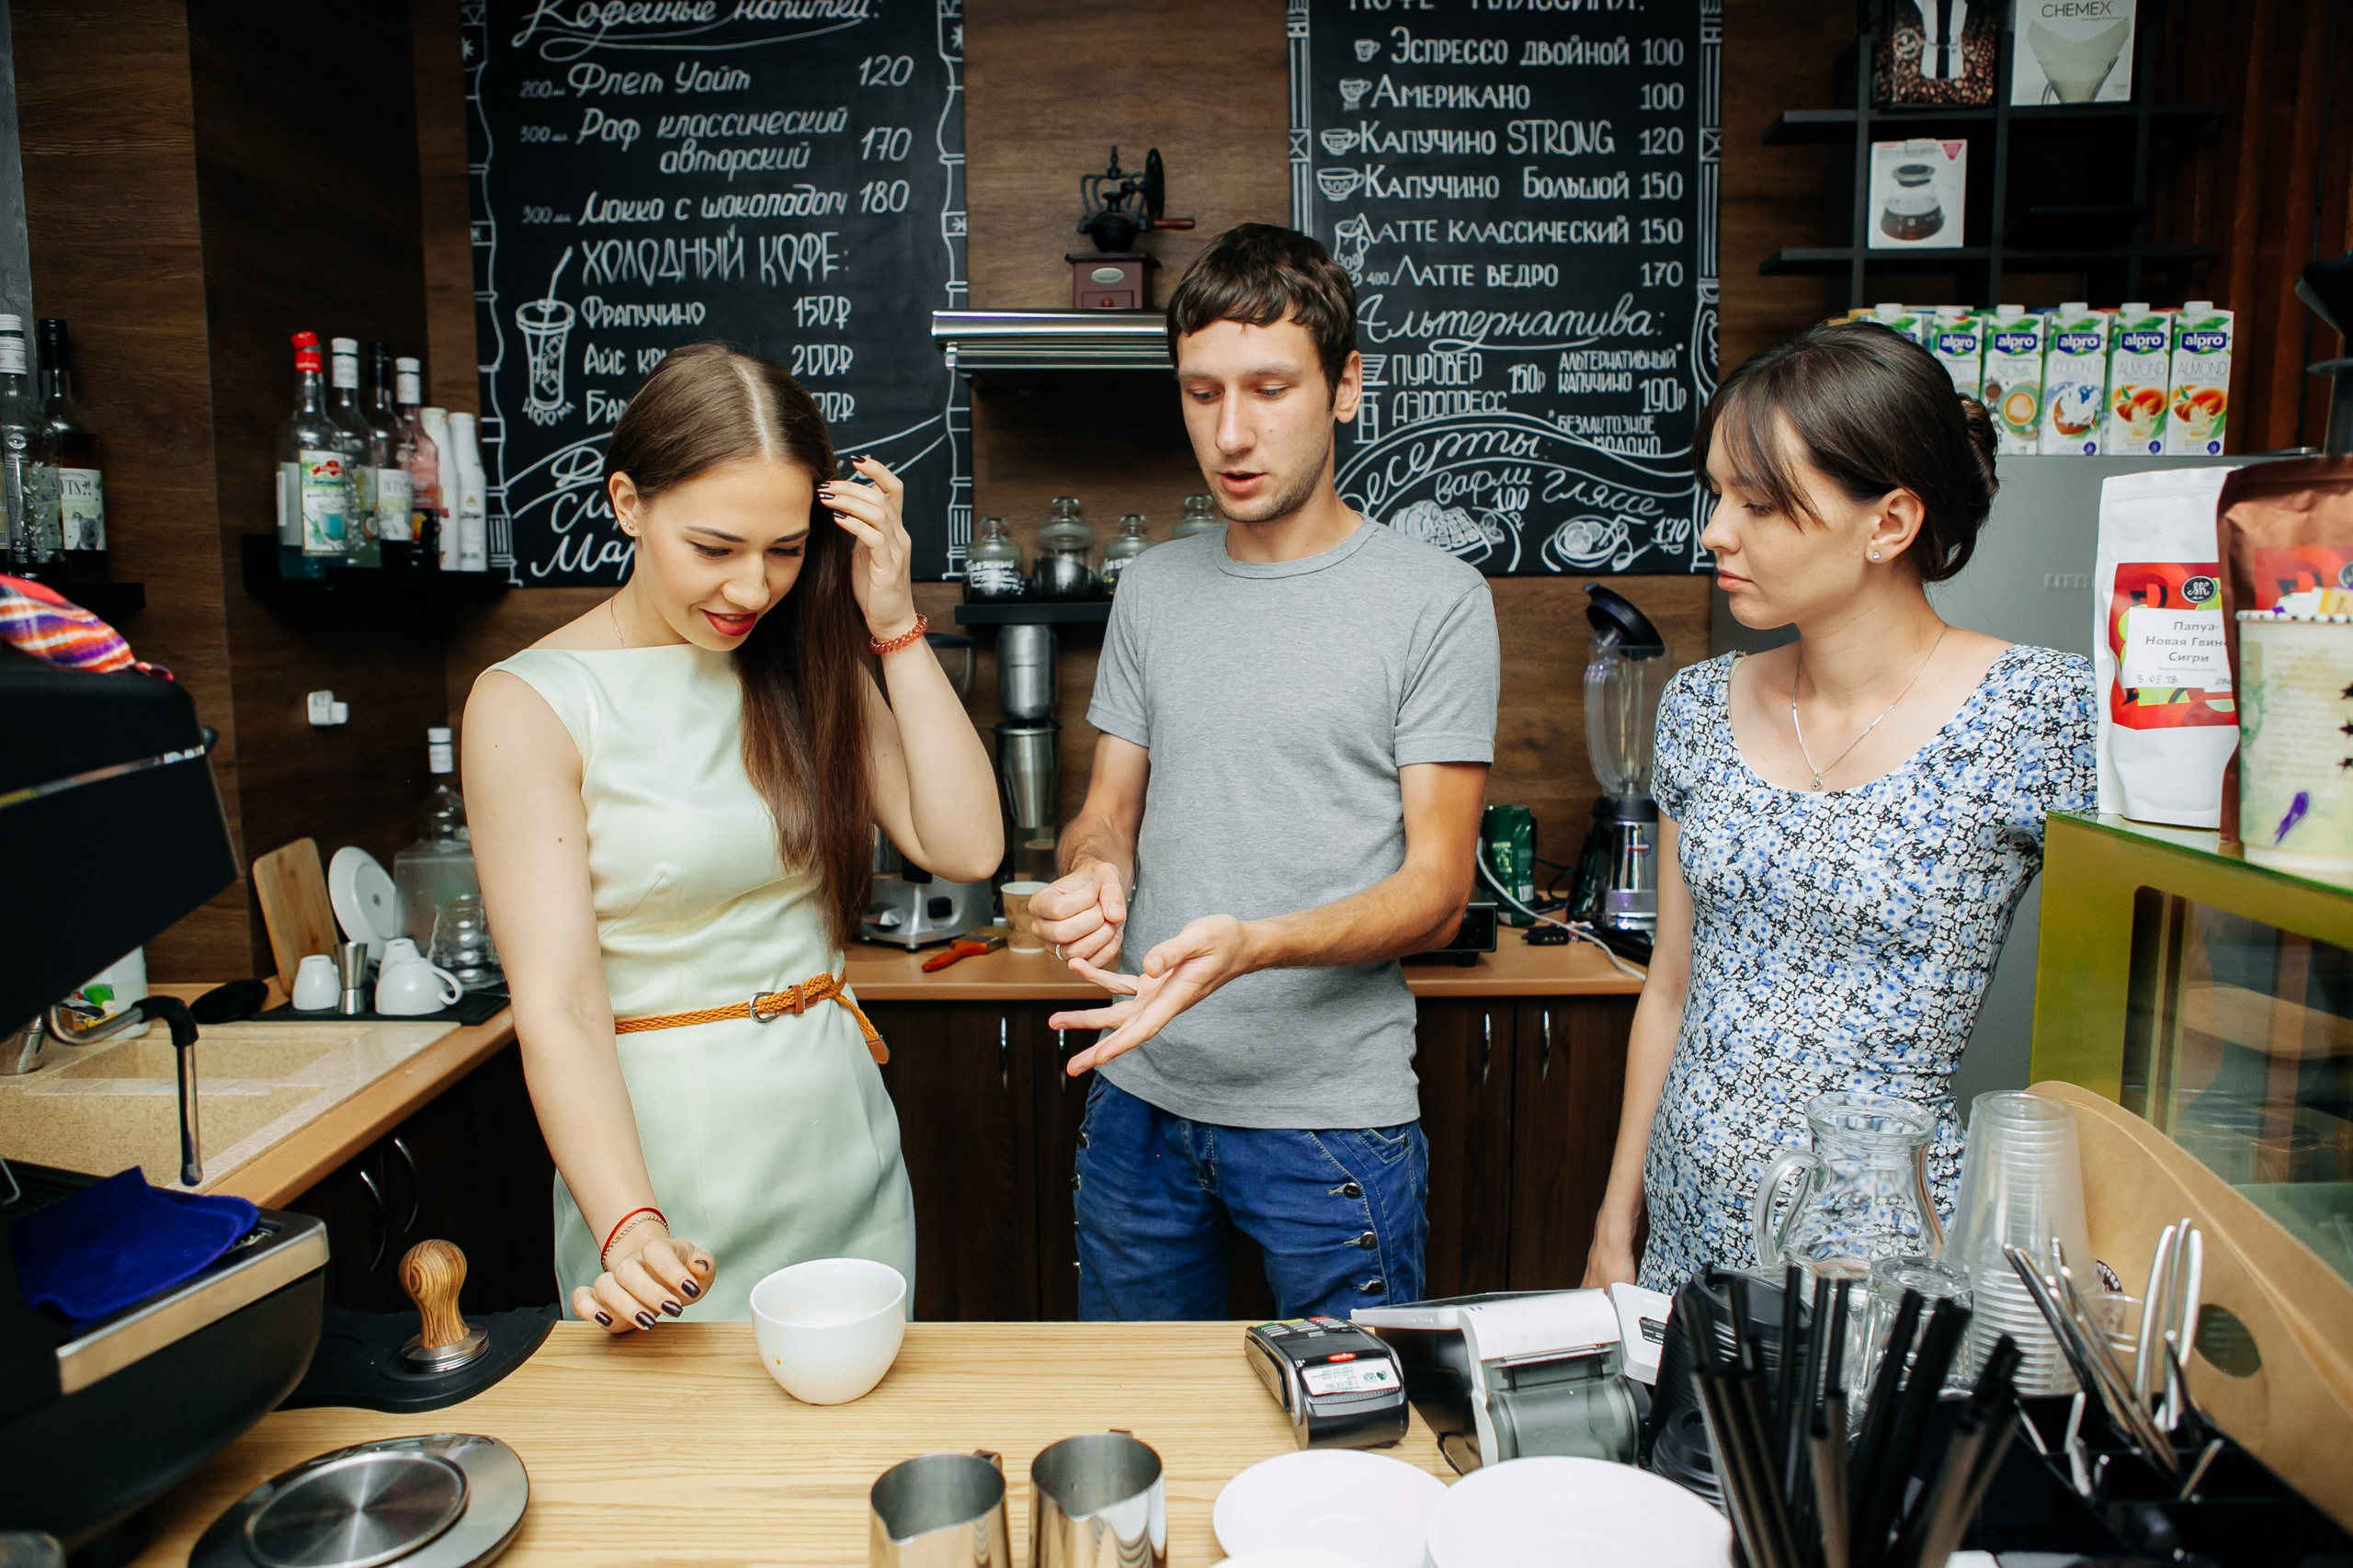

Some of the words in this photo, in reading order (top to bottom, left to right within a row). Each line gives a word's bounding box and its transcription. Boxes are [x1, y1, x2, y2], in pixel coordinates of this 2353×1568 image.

[2040, 1, 2113, 18] CHEMEX
[1641, 38, 1684, 66] 100
[858, 54, 915, 86] 120
[1639, 82, 1684, 110] 100
[575, 108, 642, 152] Раф
[656, 106, 848, 138] классический
[859, 127, 913, 162] 170
[1506, 119, 1615, 155] STRONG
[1639, 127, 1684, 154] 120
[659, 138, 812, 182] авторский
[1639, 171, 1684, 200] 150
[701, 184, 848, 219] шоколадом
[859, 179, 910, 215] 180
[1640, 218, 1684, 244] 150
[581, 222, 745, 288] ХОЛОДНЫЙ
[1641, 260, 1684, 288] 170
[1941, 335, 1975, 352] alpro
[1997, 334, 2035, 351] alpro
[2060, 335, 2098, 351] alpro
[2124, 334, 2162, 350] alpro
[2185, 334, 2223, 350] alpro
[1392, 352, 1482, 386] ПУРОВЕР
[2118, 360, 2166, 376] ALMOND
[2177, 360, 2227, 376] ALMOND
[1392, 391, 1507, 427] АЭРОПРЕСС
[1491, 487, 1529, 512] 100
[1651, 517, 1691, 543] 170
[2173, 621, 2220, 633] Папуа-
[2145, 635, 2187, 646] Новая
[2191, 637, 2226, 646] Гвин
[2168, 652, 2209, 664] Сигри
